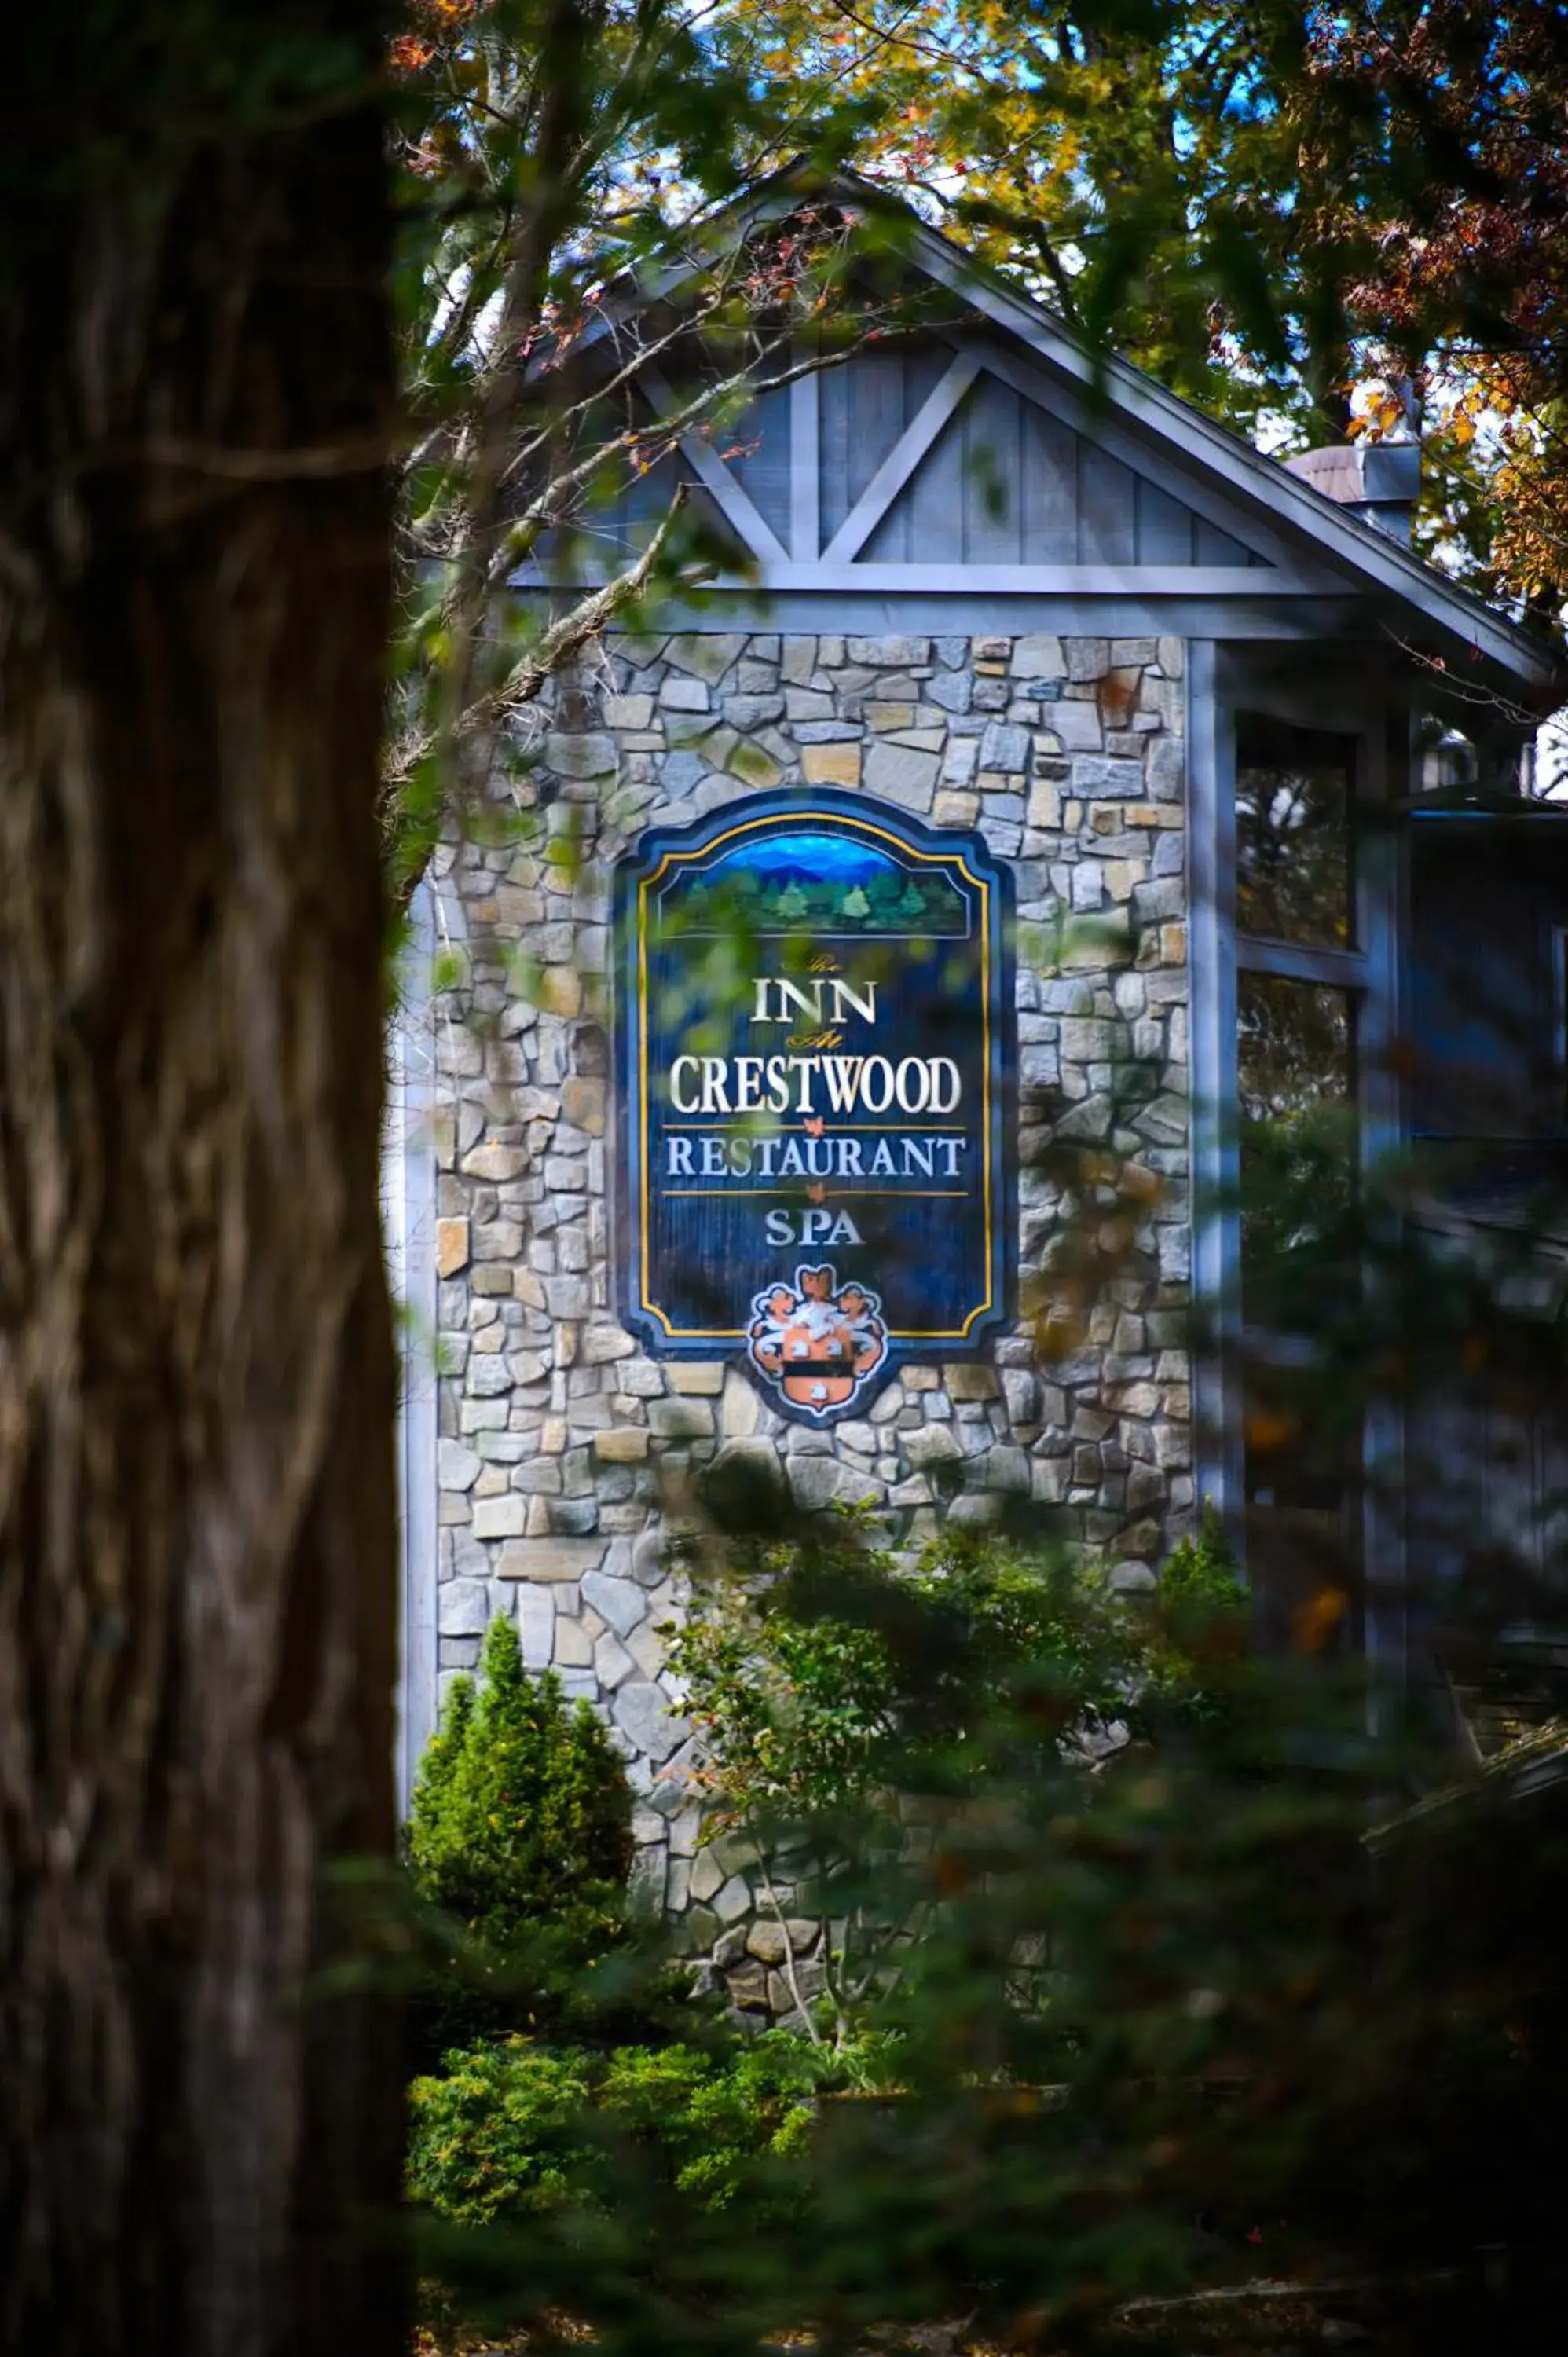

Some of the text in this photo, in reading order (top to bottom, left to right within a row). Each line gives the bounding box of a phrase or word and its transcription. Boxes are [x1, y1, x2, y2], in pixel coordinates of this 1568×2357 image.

[750, 977, 878, 1024] INN
[670, 1055, 962, 1114] CRESTWOOD
[666, 1136, 966, 1177] RESTAURANT
[765, 1208, 864, 1247] SPA
